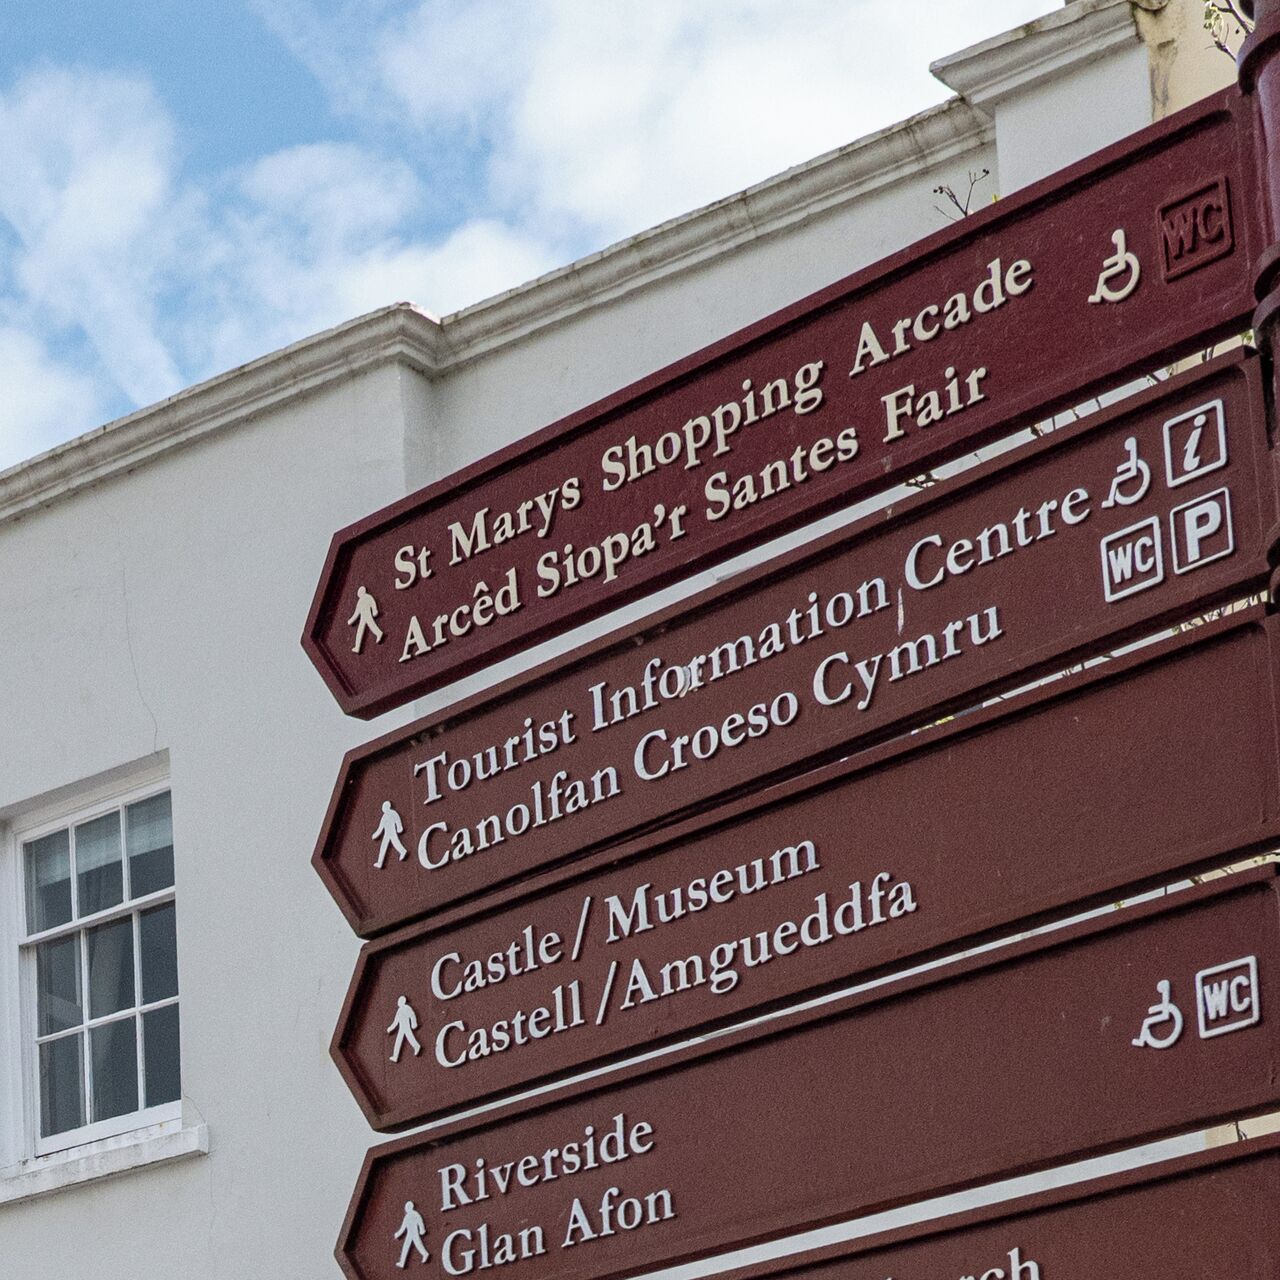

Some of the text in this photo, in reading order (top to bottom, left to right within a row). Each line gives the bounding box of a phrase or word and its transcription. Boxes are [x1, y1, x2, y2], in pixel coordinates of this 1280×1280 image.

[1162, 203, 1223, 260] WC
[394, 257, 1033, 589] St Marys Shopping Arcade
[399, 367, 987, 662] Arcêd Siopa'r Santes Fair
[1108, 500, 1221, 584] WC P
[414, 487, 1091, 805] Tourist Information Centre
[418, 606, 1003, 870] Canolfan Croeso Cymru
[1203, 975, 1251, 1020] WC
[437, 1113, 655, 1212] Riverside
[441, 1186, 677, 1276] Glan Afon
